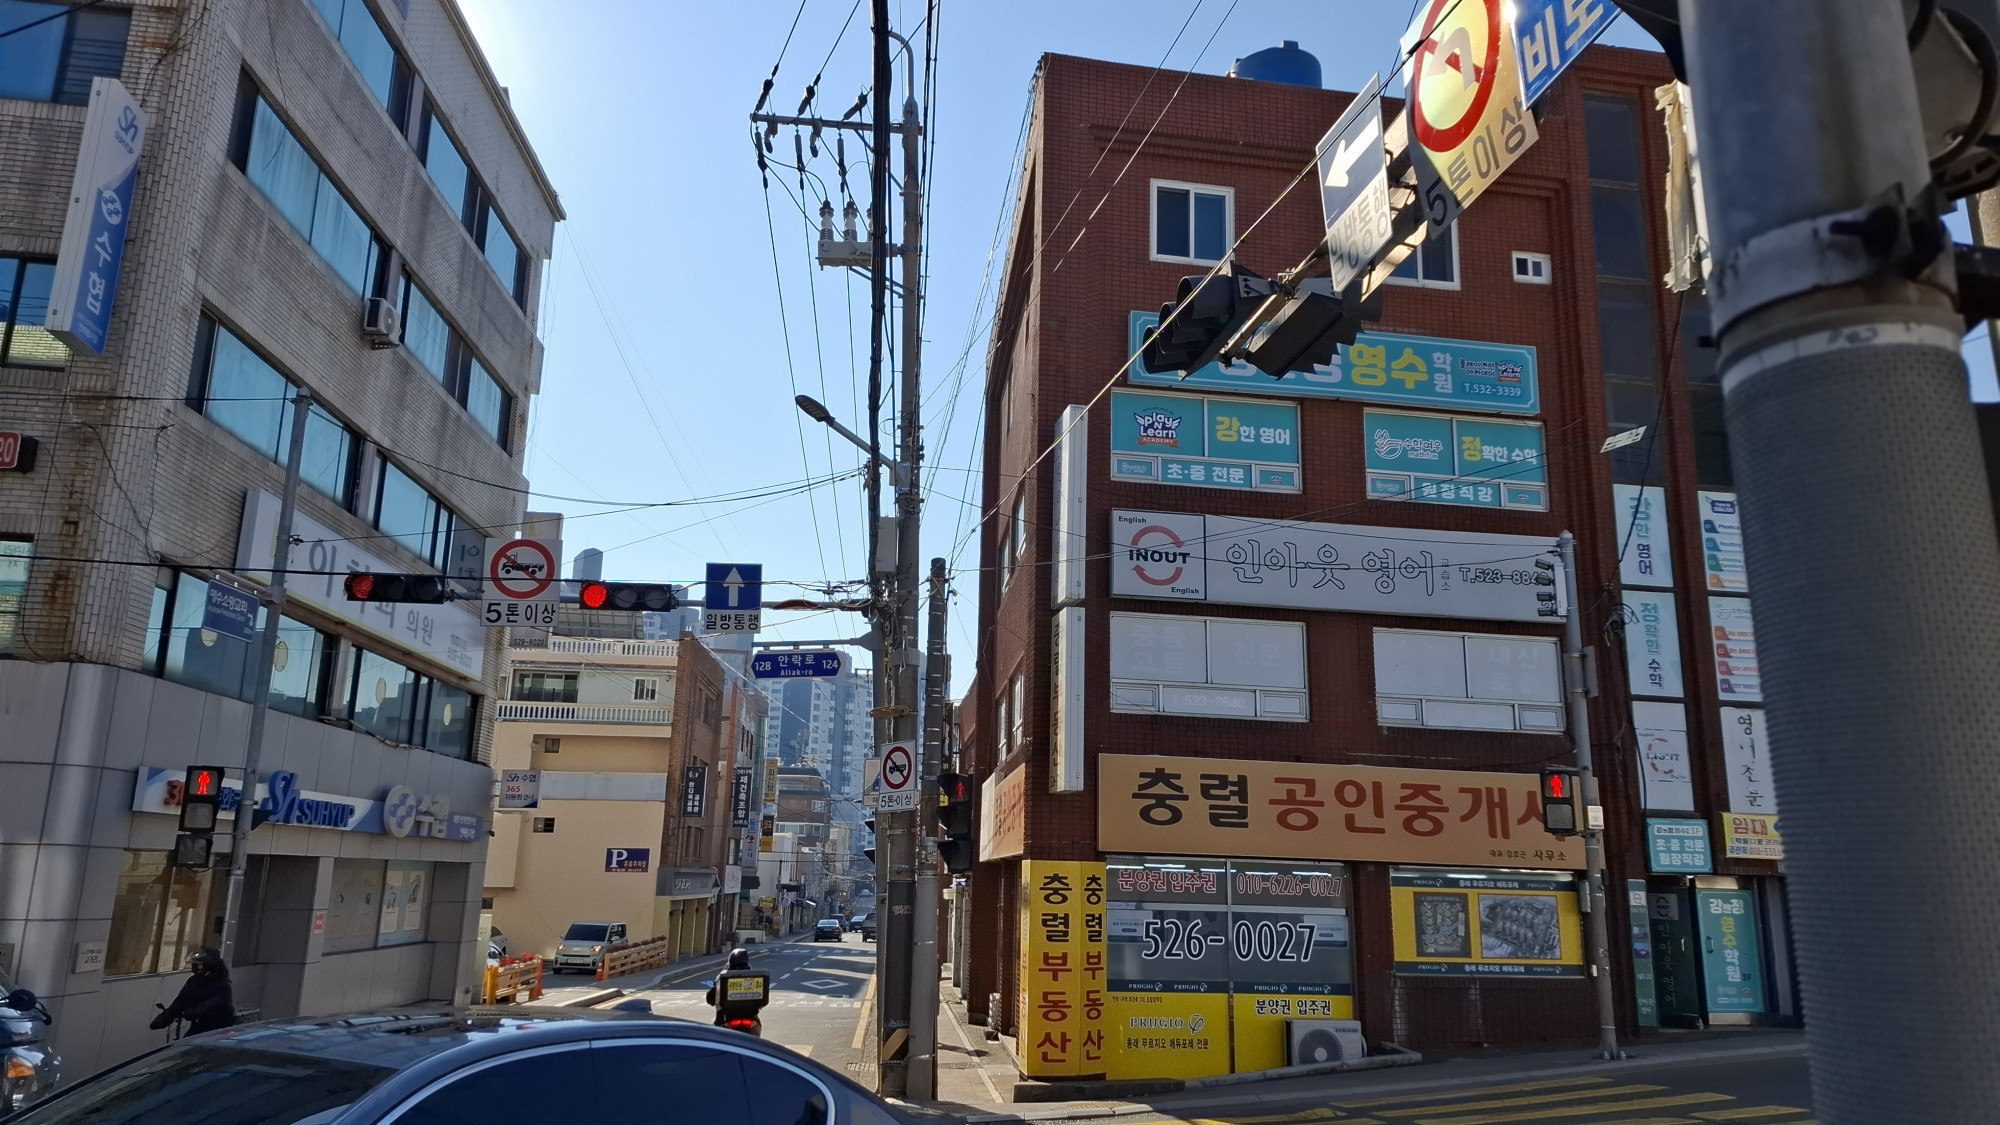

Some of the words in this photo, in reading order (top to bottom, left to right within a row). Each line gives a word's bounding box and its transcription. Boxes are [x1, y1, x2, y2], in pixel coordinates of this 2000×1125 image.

[1330, 176, 1390, 287] 일방통행
[86, 231, 113, 316] 수협
[1464, 382, 1521, 397] T.532-3339
[1140, 425, 1176, 438] Learn
[1216, 416, 1255, 443] 강한
[1259, 427, 1290, 446] 영어
[1404, 438, 1444, 452] 수학여우
[1461, 436, 1508, 463] 정확한
[1511, 449, 1538, 465] 수학
[1407, 450, 1439, 460] mathfox
[1212, 467, 1244, 484] 전문
[1421, 481, 1494, 503] 원장직강
[1118, 515, 1147, 524] English
[1128, 549, 1191, 565] INOUT
[1226, 538, 1350, 590] 인아웃
[1361, 548, 1435, 597] 영어
[1171, 586, 1200, 595] English
[706, 613, 759, 631] 일방통행
[755, 661, 771, 671] 128
[778, 655, 815, 667] 안락로
[822, 660, 838, 669] 124
[301, 800, 354, 827] SUHYUP
[1732, 817, 1768, 835] 임대
[609, 849, 628, 867] P
[1533, 850, 1567, 861] 사무소
[1118, 870, 1167, 892] 분양권
[1170, 872, 1217, 894] 입주권
[1236, 873, 1342, 897] 010-6226-0027
[1037, 873, 1073, 1064] 충렬부동산
[1083, 874, 1104, 1060] 충렬부동산
[1256, 999, 1291, 1015] 분양권
[1297, 1000, 1331, 1016] 입주권
[1130, 1017, 1184, 1028] PRUGIO
[1127, 1038, 1139, 1049] 동래
[1142, 1038, 1167, 1049] 푸르지오
[1196, 1038, 1209, 1050] 전문
